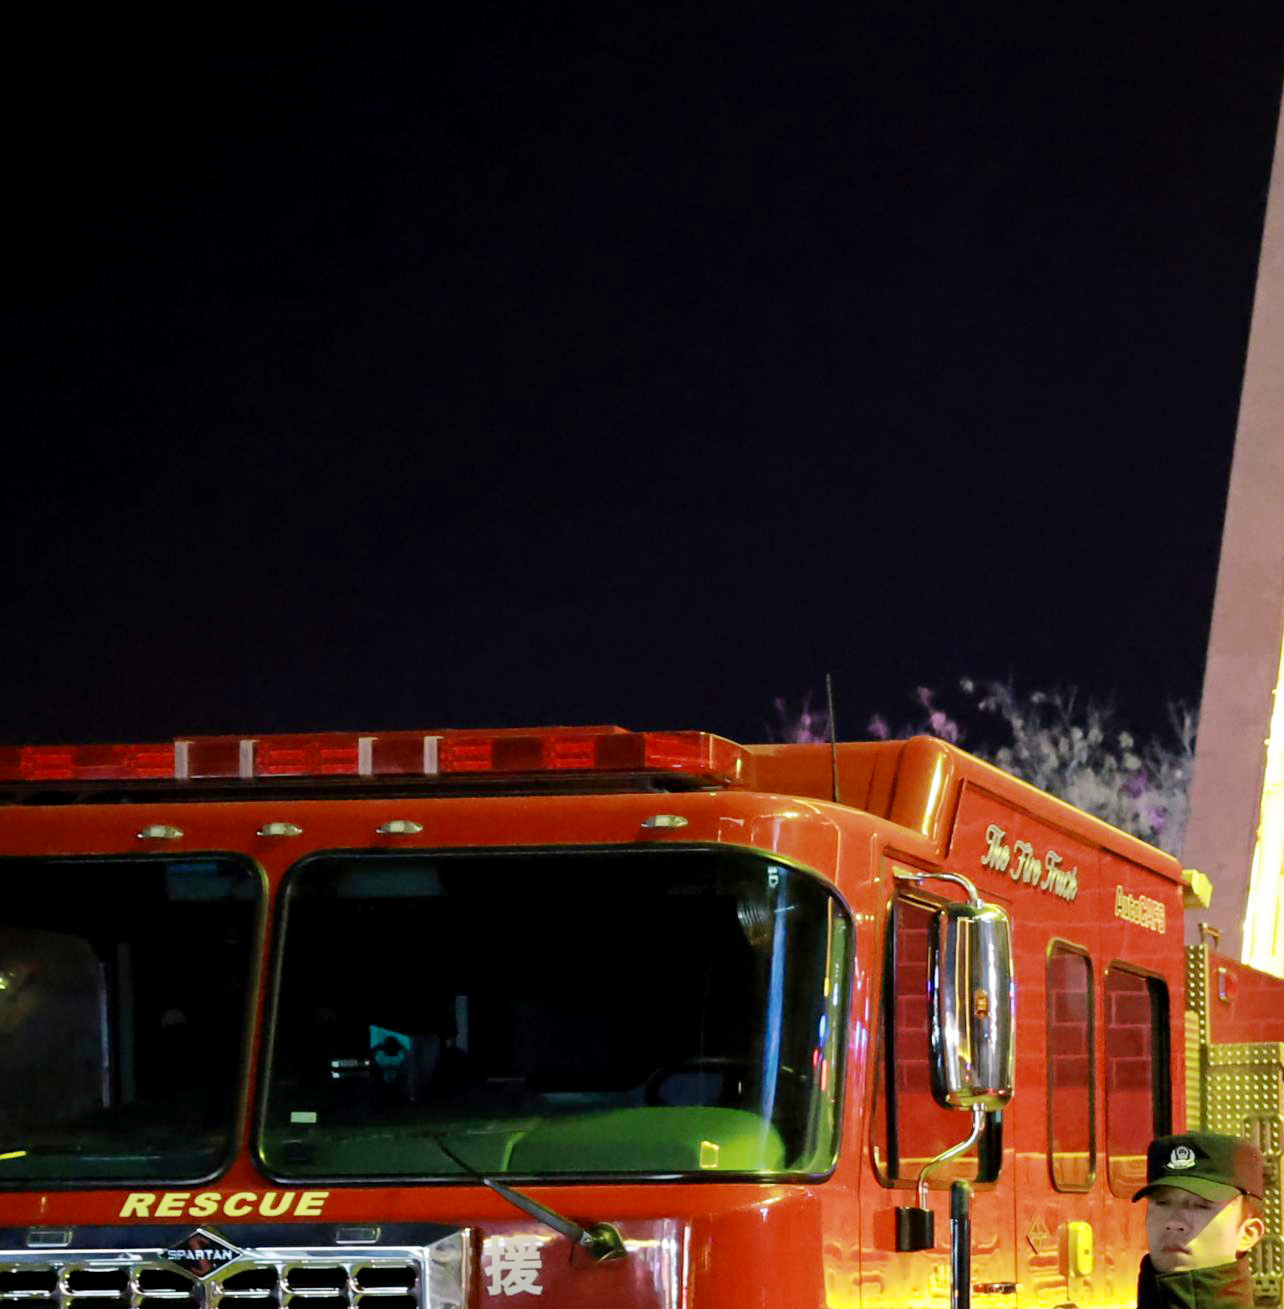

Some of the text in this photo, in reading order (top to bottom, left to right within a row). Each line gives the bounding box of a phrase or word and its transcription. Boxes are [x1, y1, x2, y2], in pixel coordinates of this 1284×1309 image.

[981, 823, 1011, 872] The
[119, 1192, 329, 1217] RESCUE
[167, 1250, 233, 1260] SPARTAN
[483, 1235, 545, 1297] 援
